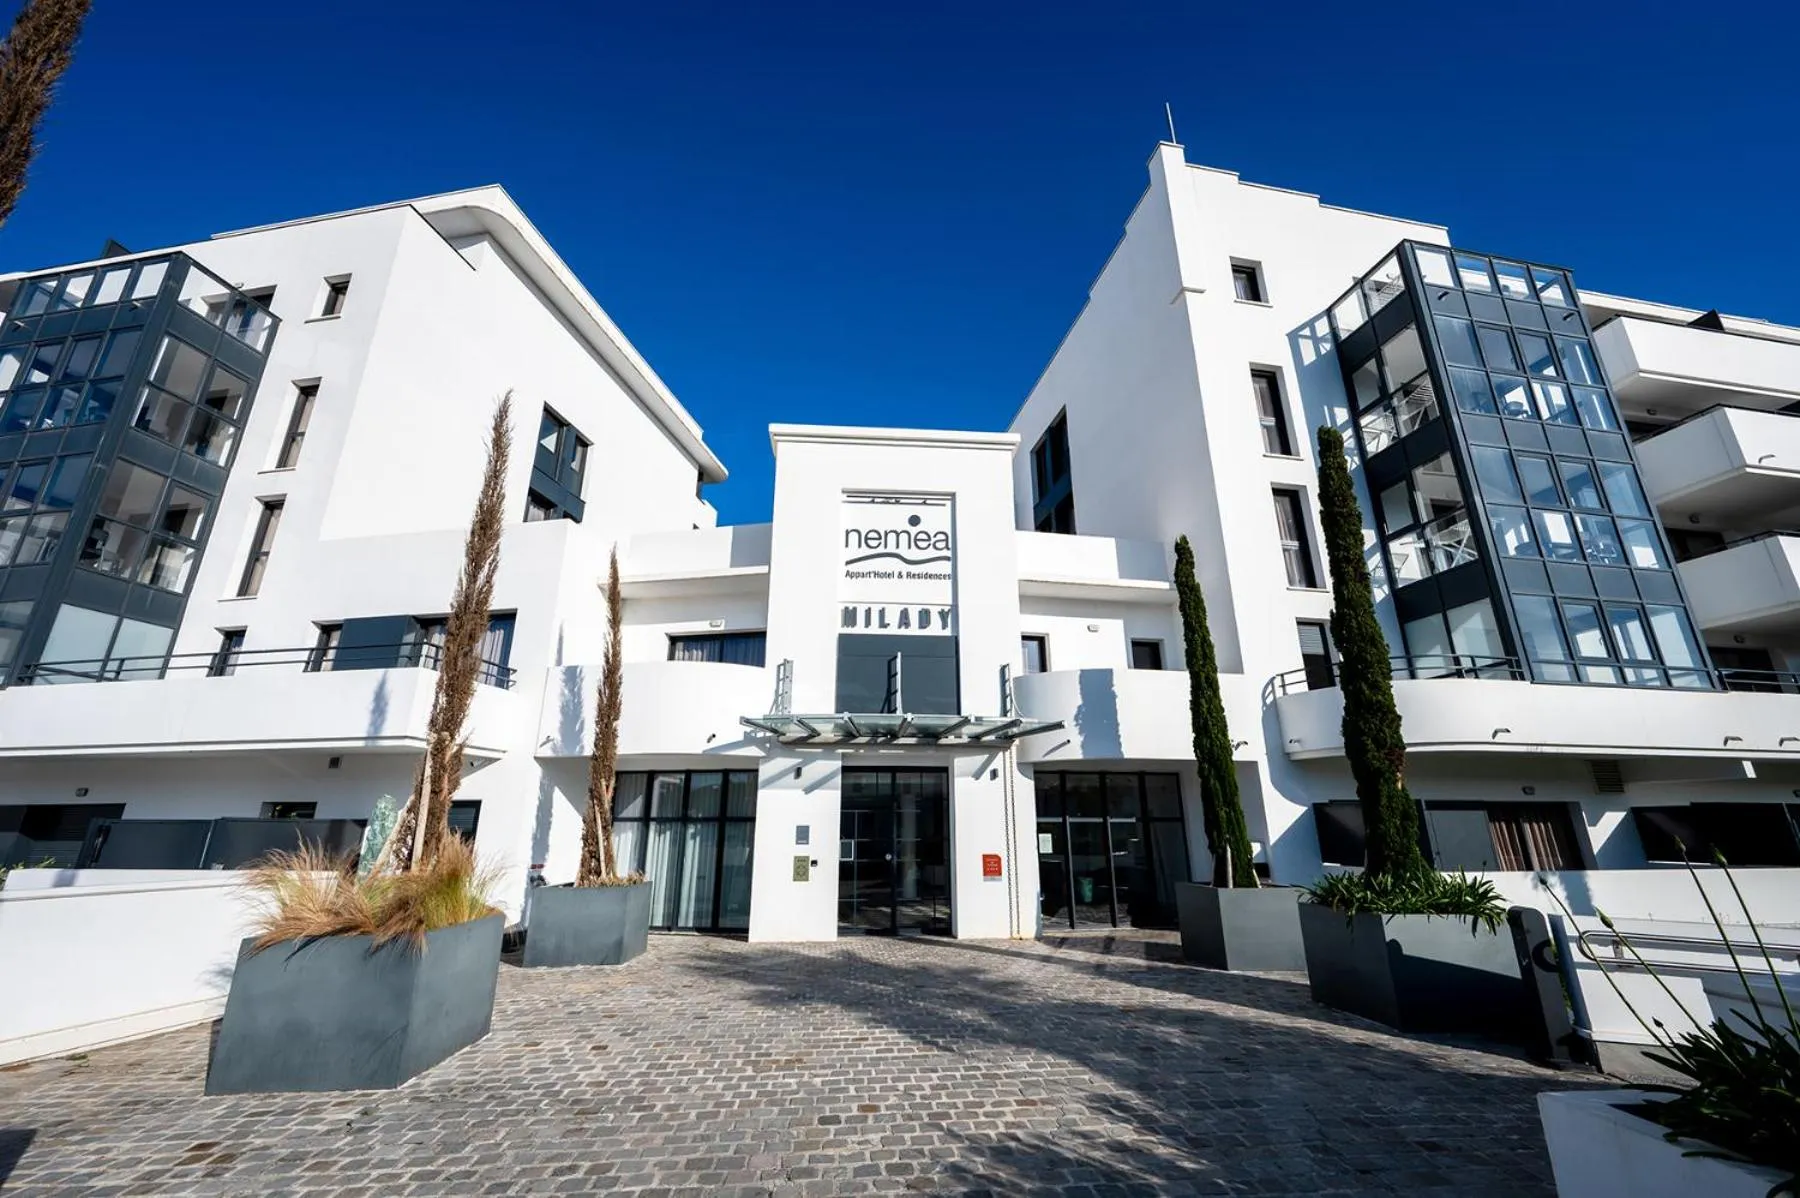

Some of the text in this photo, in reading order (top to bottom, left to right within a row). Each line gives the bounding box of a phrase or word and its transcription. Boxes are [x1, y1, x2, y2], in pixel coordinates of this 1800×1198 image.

[897, 571, 903, 579] &
[906, 571, 951, 581] Residences
[841, 606, 952, 630] MILADY
